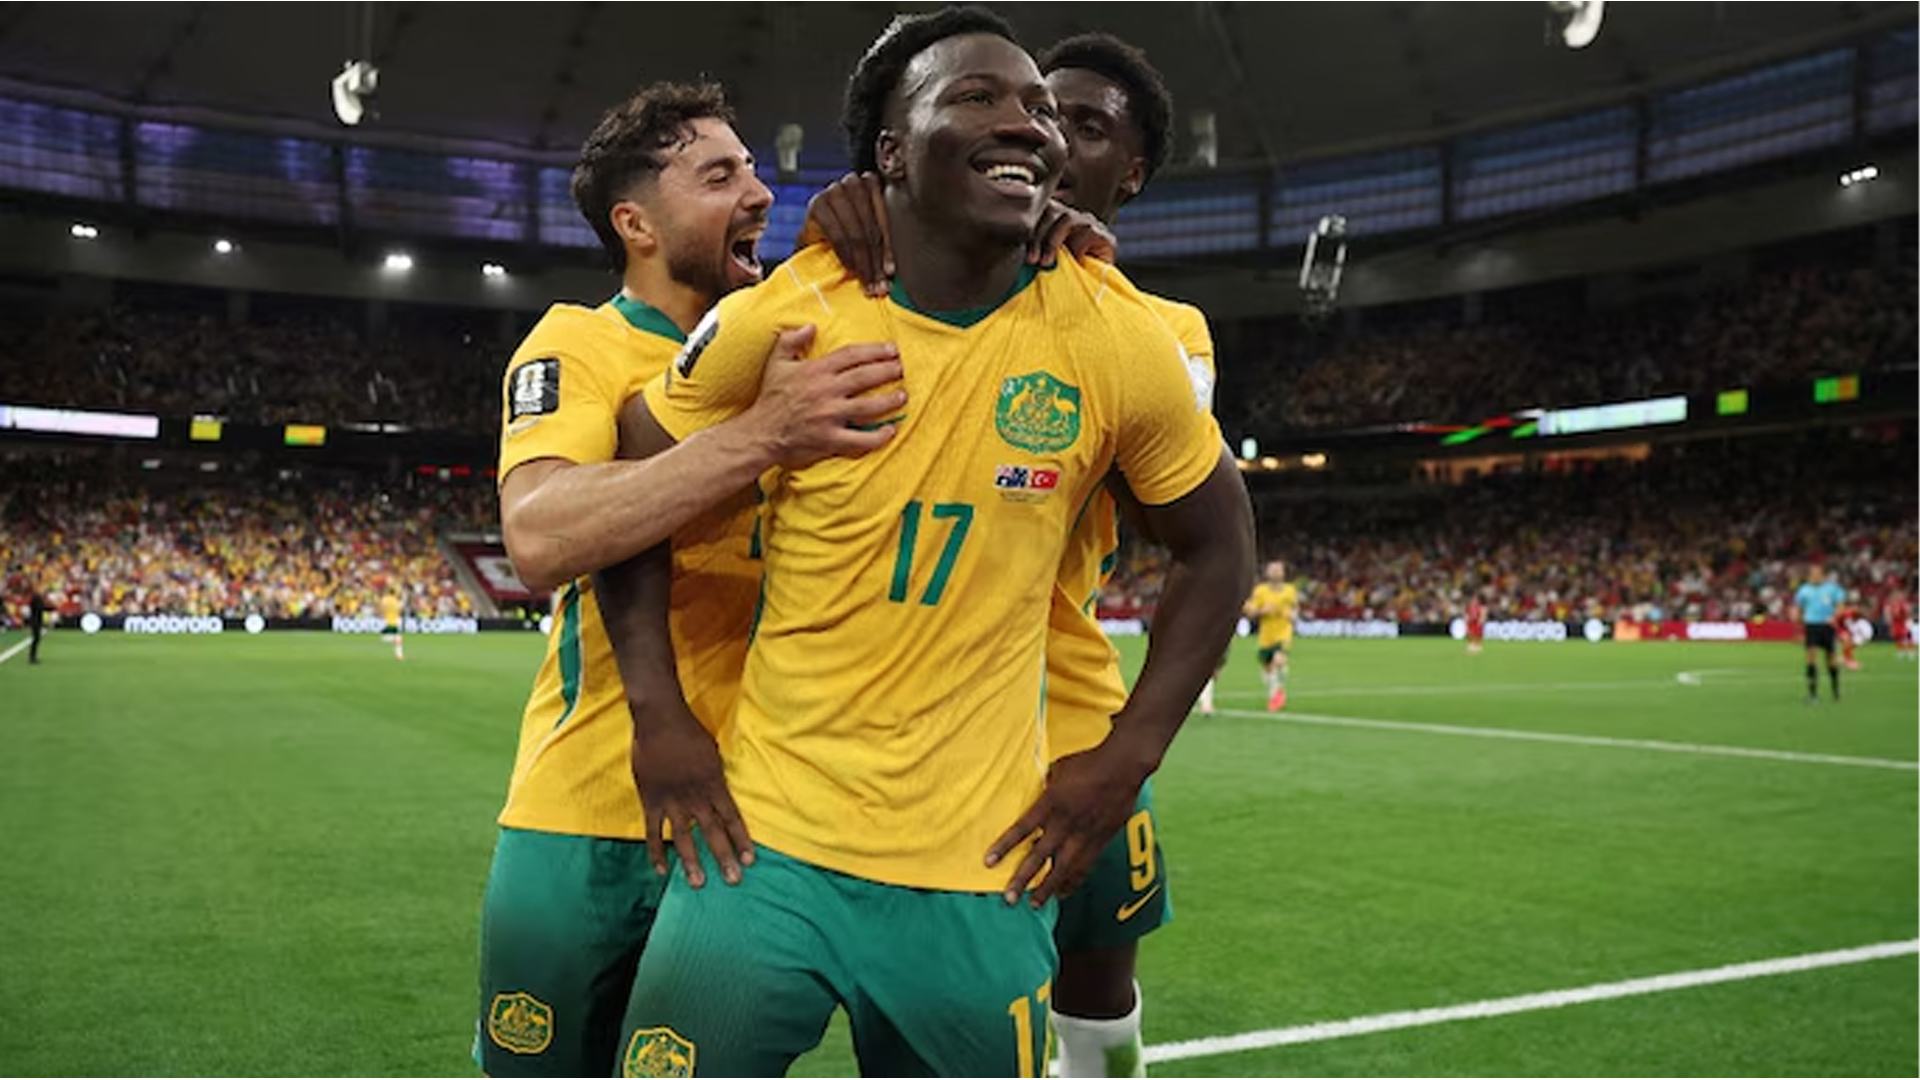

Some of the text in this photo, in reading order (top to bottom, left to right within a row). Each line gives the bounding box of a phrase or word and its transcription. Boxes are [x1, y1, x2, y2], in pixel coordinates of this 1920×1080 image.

[888, 500, 974, 606] 17
[125, 614, 223, 633] motorola
[1126, 810, 1156, 892] 9
